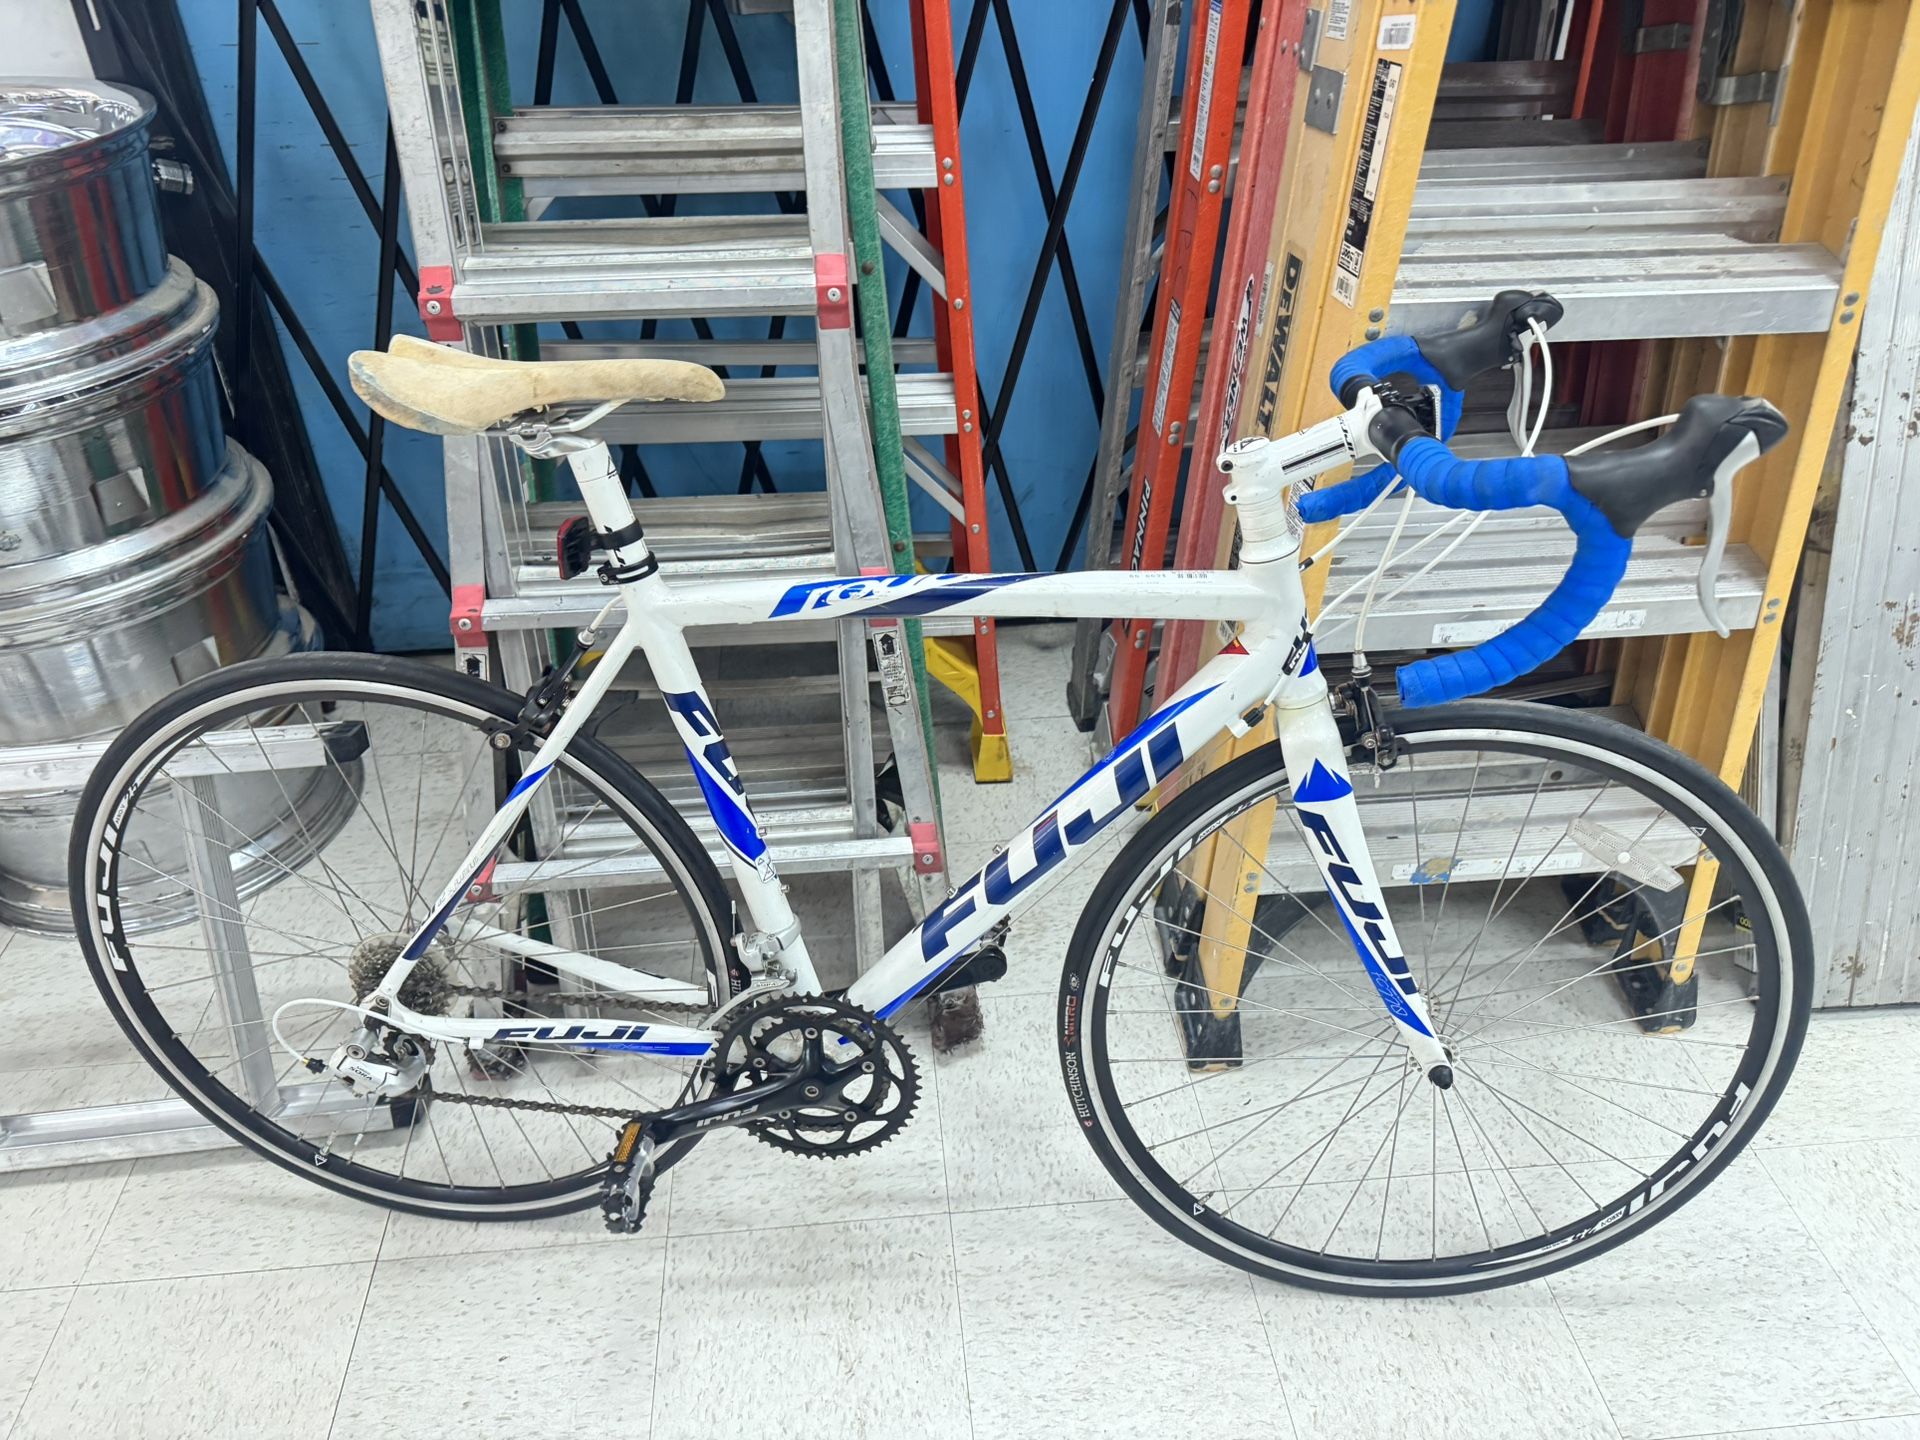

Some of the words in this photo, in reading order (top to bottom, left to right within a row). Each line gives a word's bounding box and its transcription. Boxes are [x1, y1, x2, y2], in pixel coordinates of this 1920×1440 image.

[1257, 252, 1303, 434] DEWALT
[1131, 478, 1151, 571] PINNAC
[97, 823, 128, 972] FUJI
[920, 721, 1184, 963] FUJI
[1297, 807, 1418, 996] FUJI
[1099, 837, 1194, 988] FUJI
[490, 1025, 650, 1040] FUJI
[1065, 995, 1077, 1035] NITRO
[697, 1104, 759, 1128] FUJI
[1064, 1051, 1091, 1118] HUTCHINSON
[1628, 1081, 1751, 1216] FUJI
